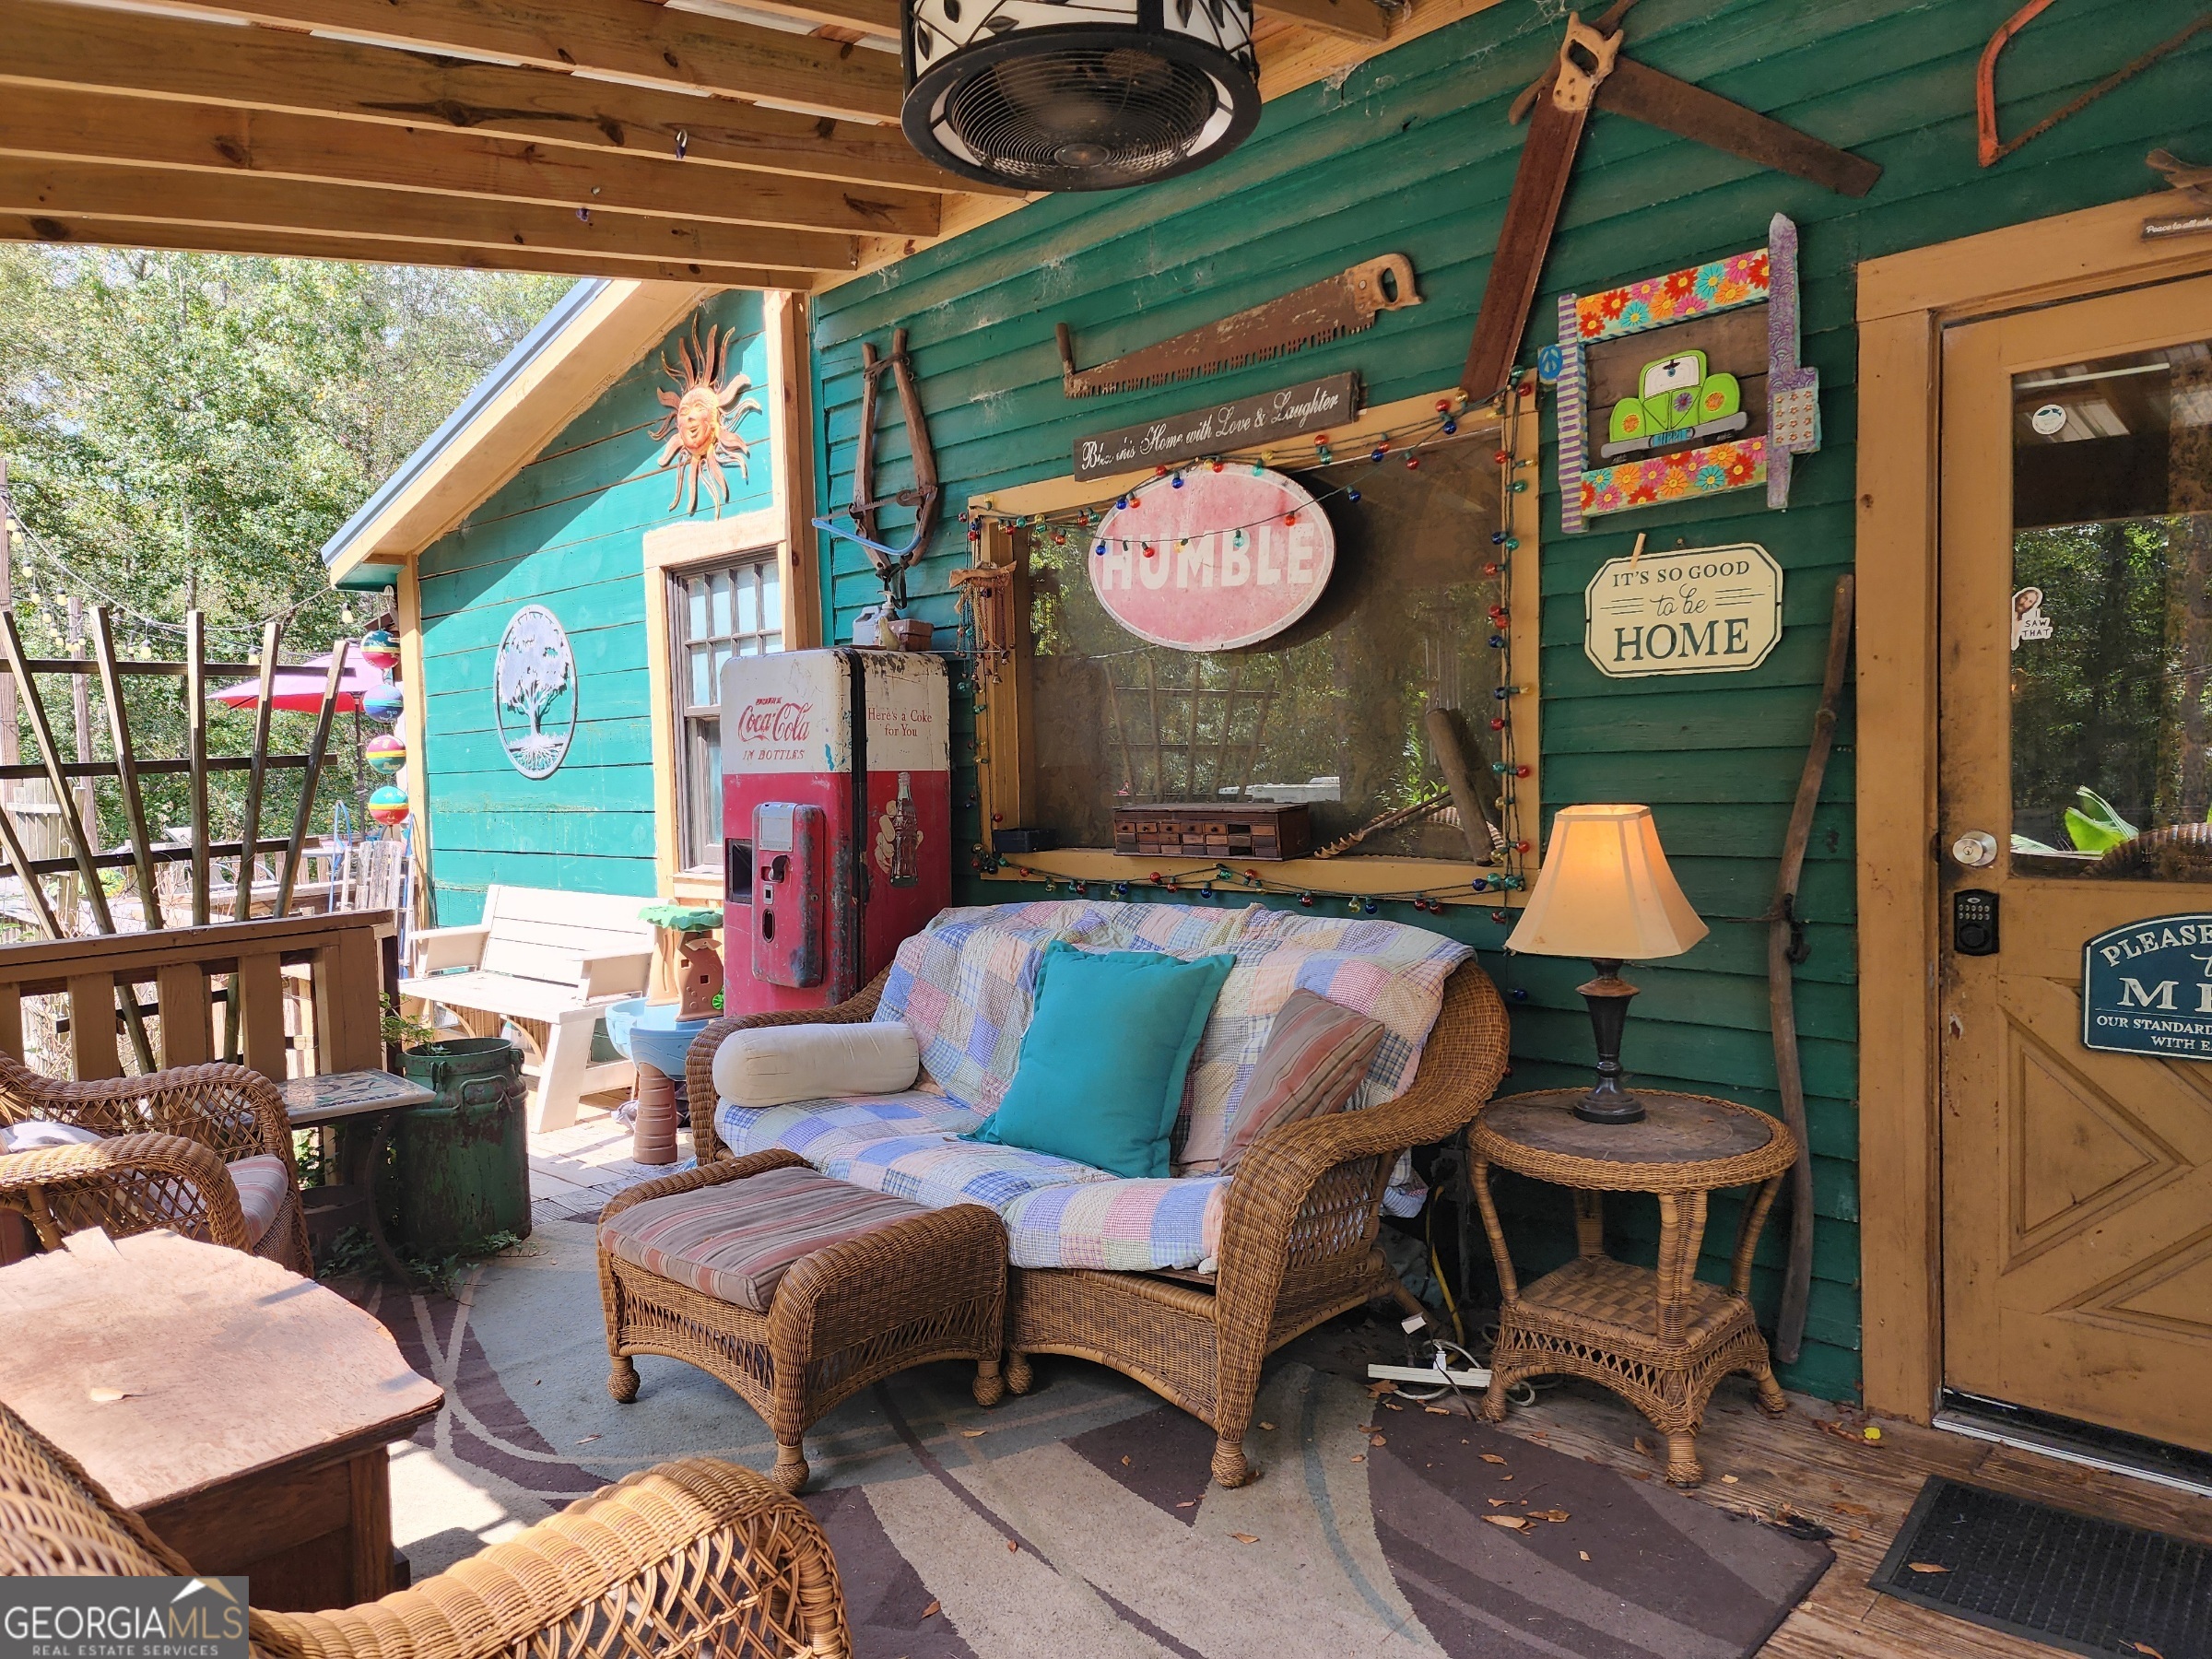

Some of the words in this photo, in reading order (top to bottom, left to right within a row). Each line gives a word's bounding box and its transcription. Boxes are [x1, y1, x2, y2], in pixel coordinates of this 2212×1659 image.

[1139, 423, 1184, 455] Home
[1185, 413, 1213, 444] with
[1215, 406, 1251, 437] Love
[1253, 407, 1267, 428] &
[1271, 386, 1339, 429] Laughter
[1101, 522, 1315, 591] HUMBLE
[1612, 571, 1650, 587] IT'S
[1657, 567, 1682, 583] SO
[1688, 560, 1749, 580] GOOD
[1650, 594, 1678, 617] to
[1678, 582, 1709, 615] be
[2022, 629, 2050, 637] THAT
[2025, 619, 2047, 628] SAW
[1612, 618, 1749, 663] HOME
[737, 702, 813, 742] Coca-Cola
[868, 707, 898, 721] Here's
[901, 712, 906, 722] a
[910, 709, 933, 723] Coke
[885, 724, 899, 736] for
[900, 724, 918, 736] You
[743, 749, 755, 760] IN
[758, 749, 806, 760] BOTTLES
[2099, 924, 2212, 968] PLEASE
[2096, 1015, 2129, 1028] OUR
[2150, 1035, 2195, 1050] WITH
